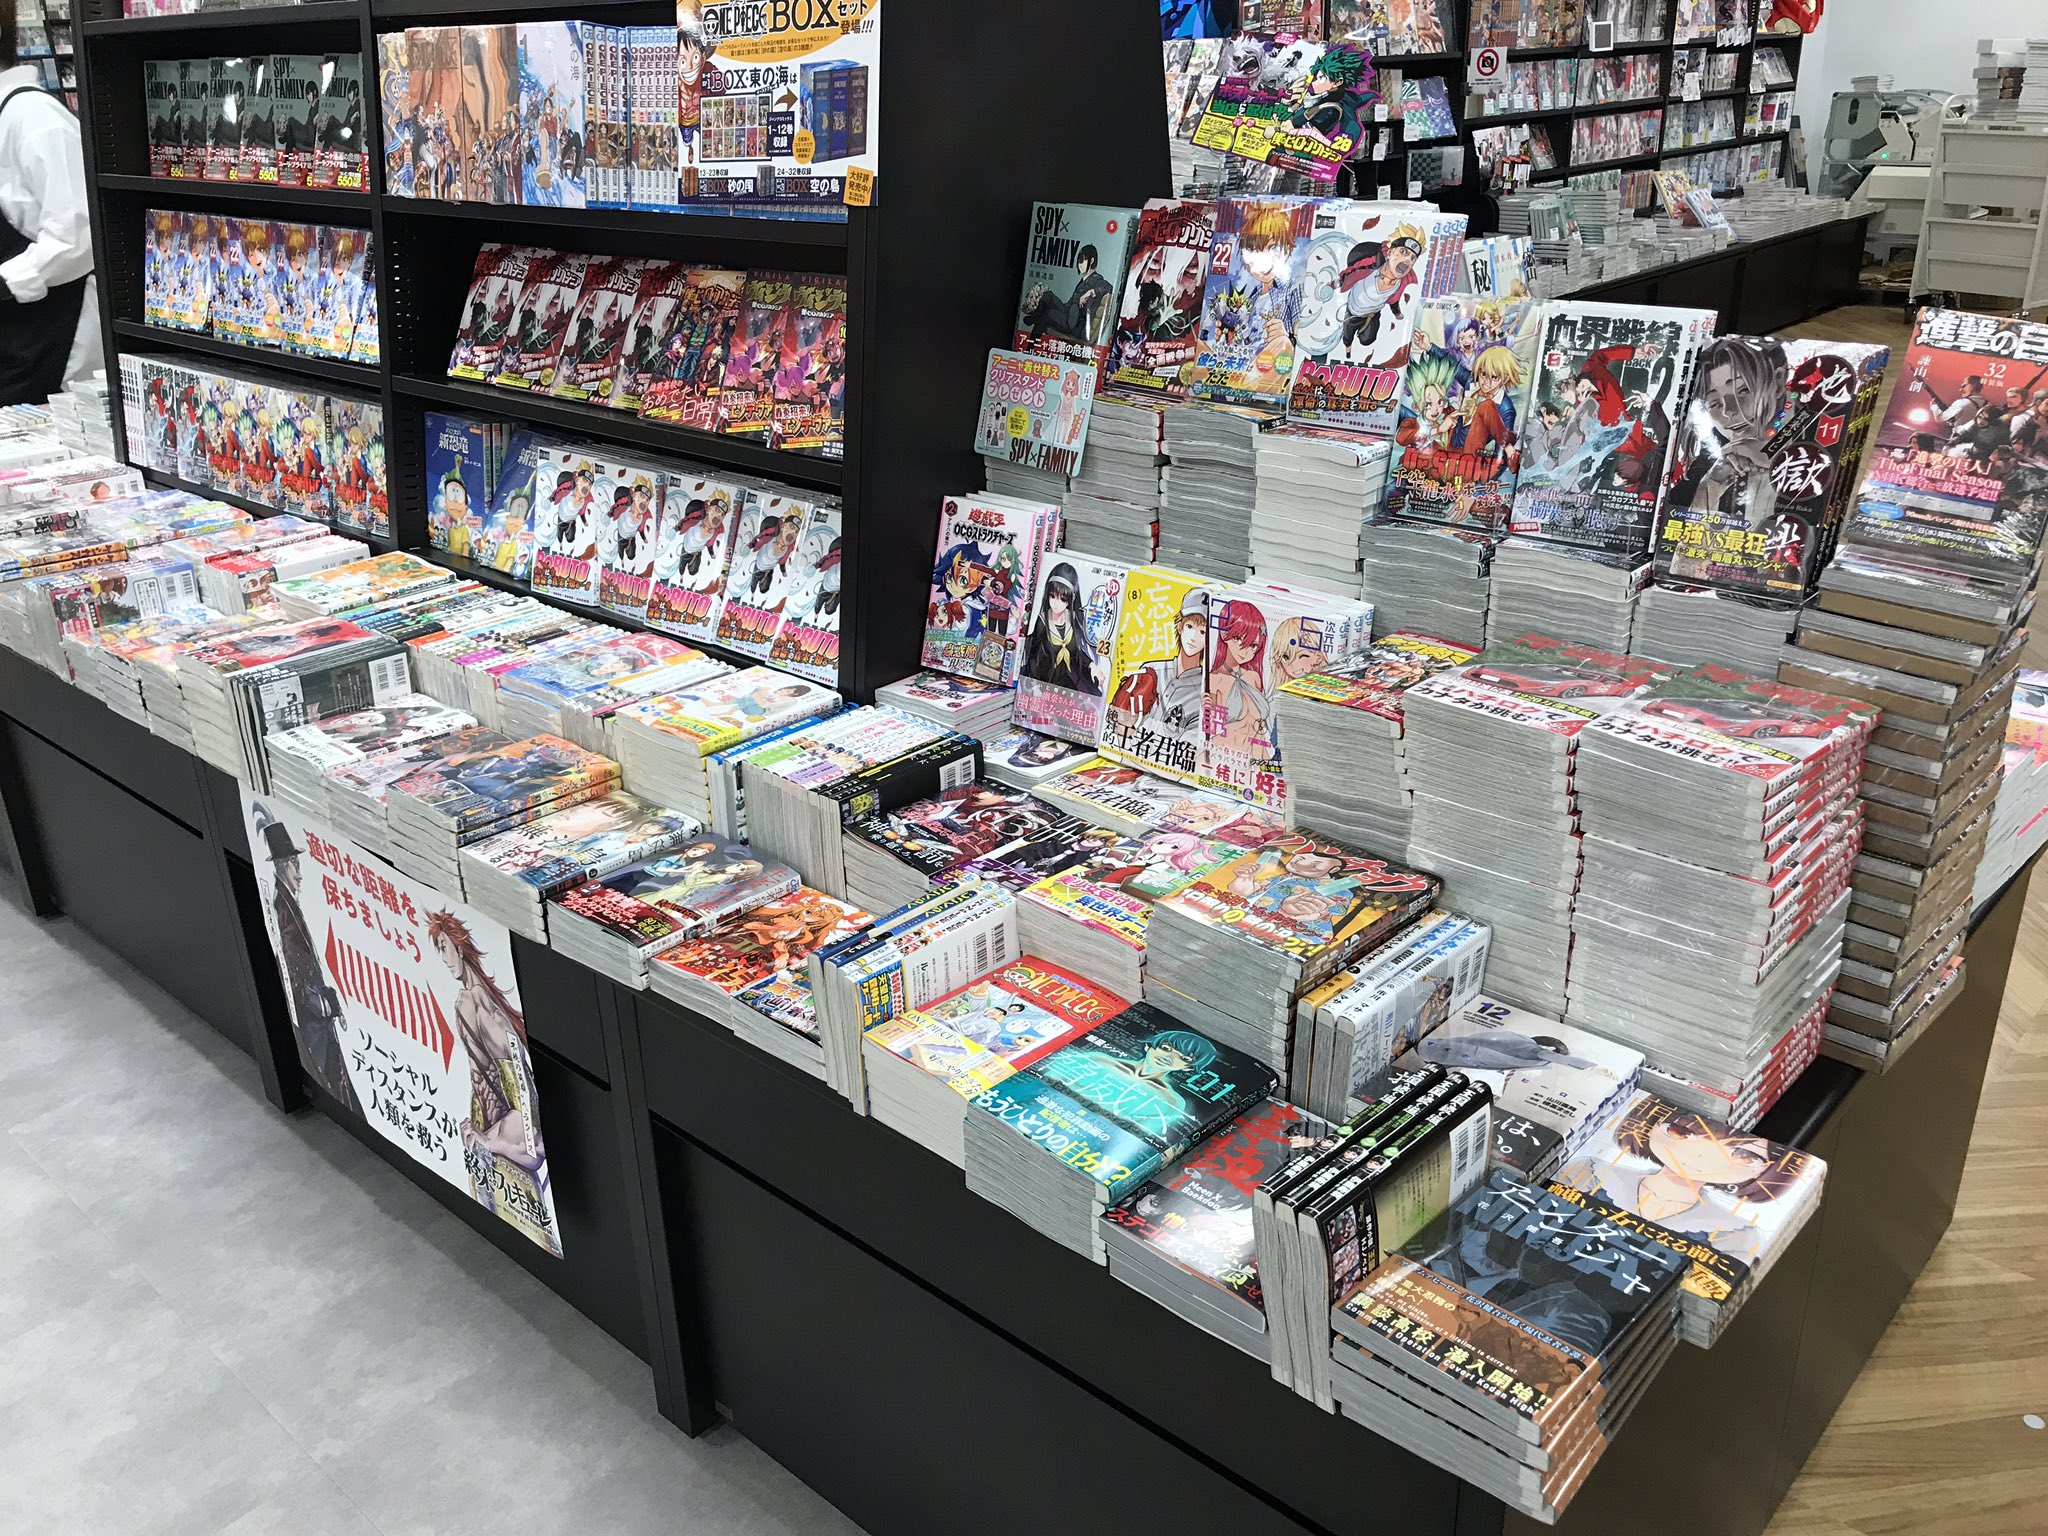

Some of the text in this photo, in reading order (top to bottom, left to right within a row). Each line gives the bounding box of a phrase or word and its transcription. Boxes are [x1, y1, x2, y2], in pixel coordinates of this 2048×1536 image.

[769, 0, 839, 32] BOX
[837, 1, 868, 17] セット
[274, 79, 305, 99] FAMILY
[773, 136, 788, 148] 収録
[1331, 136, 1353, 152] 28
[850, 171, 871, 184] 大好評
[1030, 235, 1081, 270] FAMILY
[1213, 242, 1232, 267] 22
[1547, 313, 1683, 354] 血界戦線
[990, 368, 1046, 390] クリアスタンド
[992, 354, 1061, 380] アーニャ着せ替え
[1300, 360, 1401, 401] BORUTO
[1983, 361, 2006, 380] 32
[987, 382, 1046, 407] プレゼント
[438, 432, 469, 455] 新恐竜
[1818, 422, 1842, 441] 11
[1878, 456, 2004, 490] The Final Season
[1663, 520, 1769, 555] 最強VS最狂
[1091, 567, 1119, 578] JUMP COMICS
[1144, 581, 1177, 658] 忘却
[1097, 639, 1111, 657] 23
[1016, 692, 1099, 731] 幽霊になった理由
[1113, 722, 1198, 775] 王者君臨
[1211, 752, 1249, 769] バラバラでも
[304, 828, 418, 930] 適切な距離を
[321, 872, 421, 964] 保ちましょう
[1049, 984, 1111, 1022] PIECE
[1474, 1001, 1512, 1022] 12
[906, 1012, 929, 1027] ONE
[359, 1028, 440, 1098] ソーシャル
[350, 1048, 459, 1140] ディスタンスが
[369, 1090, 449, 1164] 人類を救う
[1033, 1094, 1112, 1143] 過激な犯罪動画の
[1181, 1185, 1222, 1212] Baekdoo
[1188, 1180, 1214, 1197] Meen
[1726, 1183, 1740, 1194] 9
[1397, 1300, 1409, 1311] the
[1408, 1306, 1434, 1327] mission
[1449, 1330, 1477, 1352] lifetime
[1484, 1351, 1506, 1371] carry
[1344, 1300, 1394, 1335] Commence
[1395, 1331, 1442, 1363] Operation
[1442, 1357, 1477, 1382] Covert
[1476, 1376, 1511, 1401] Kodan
